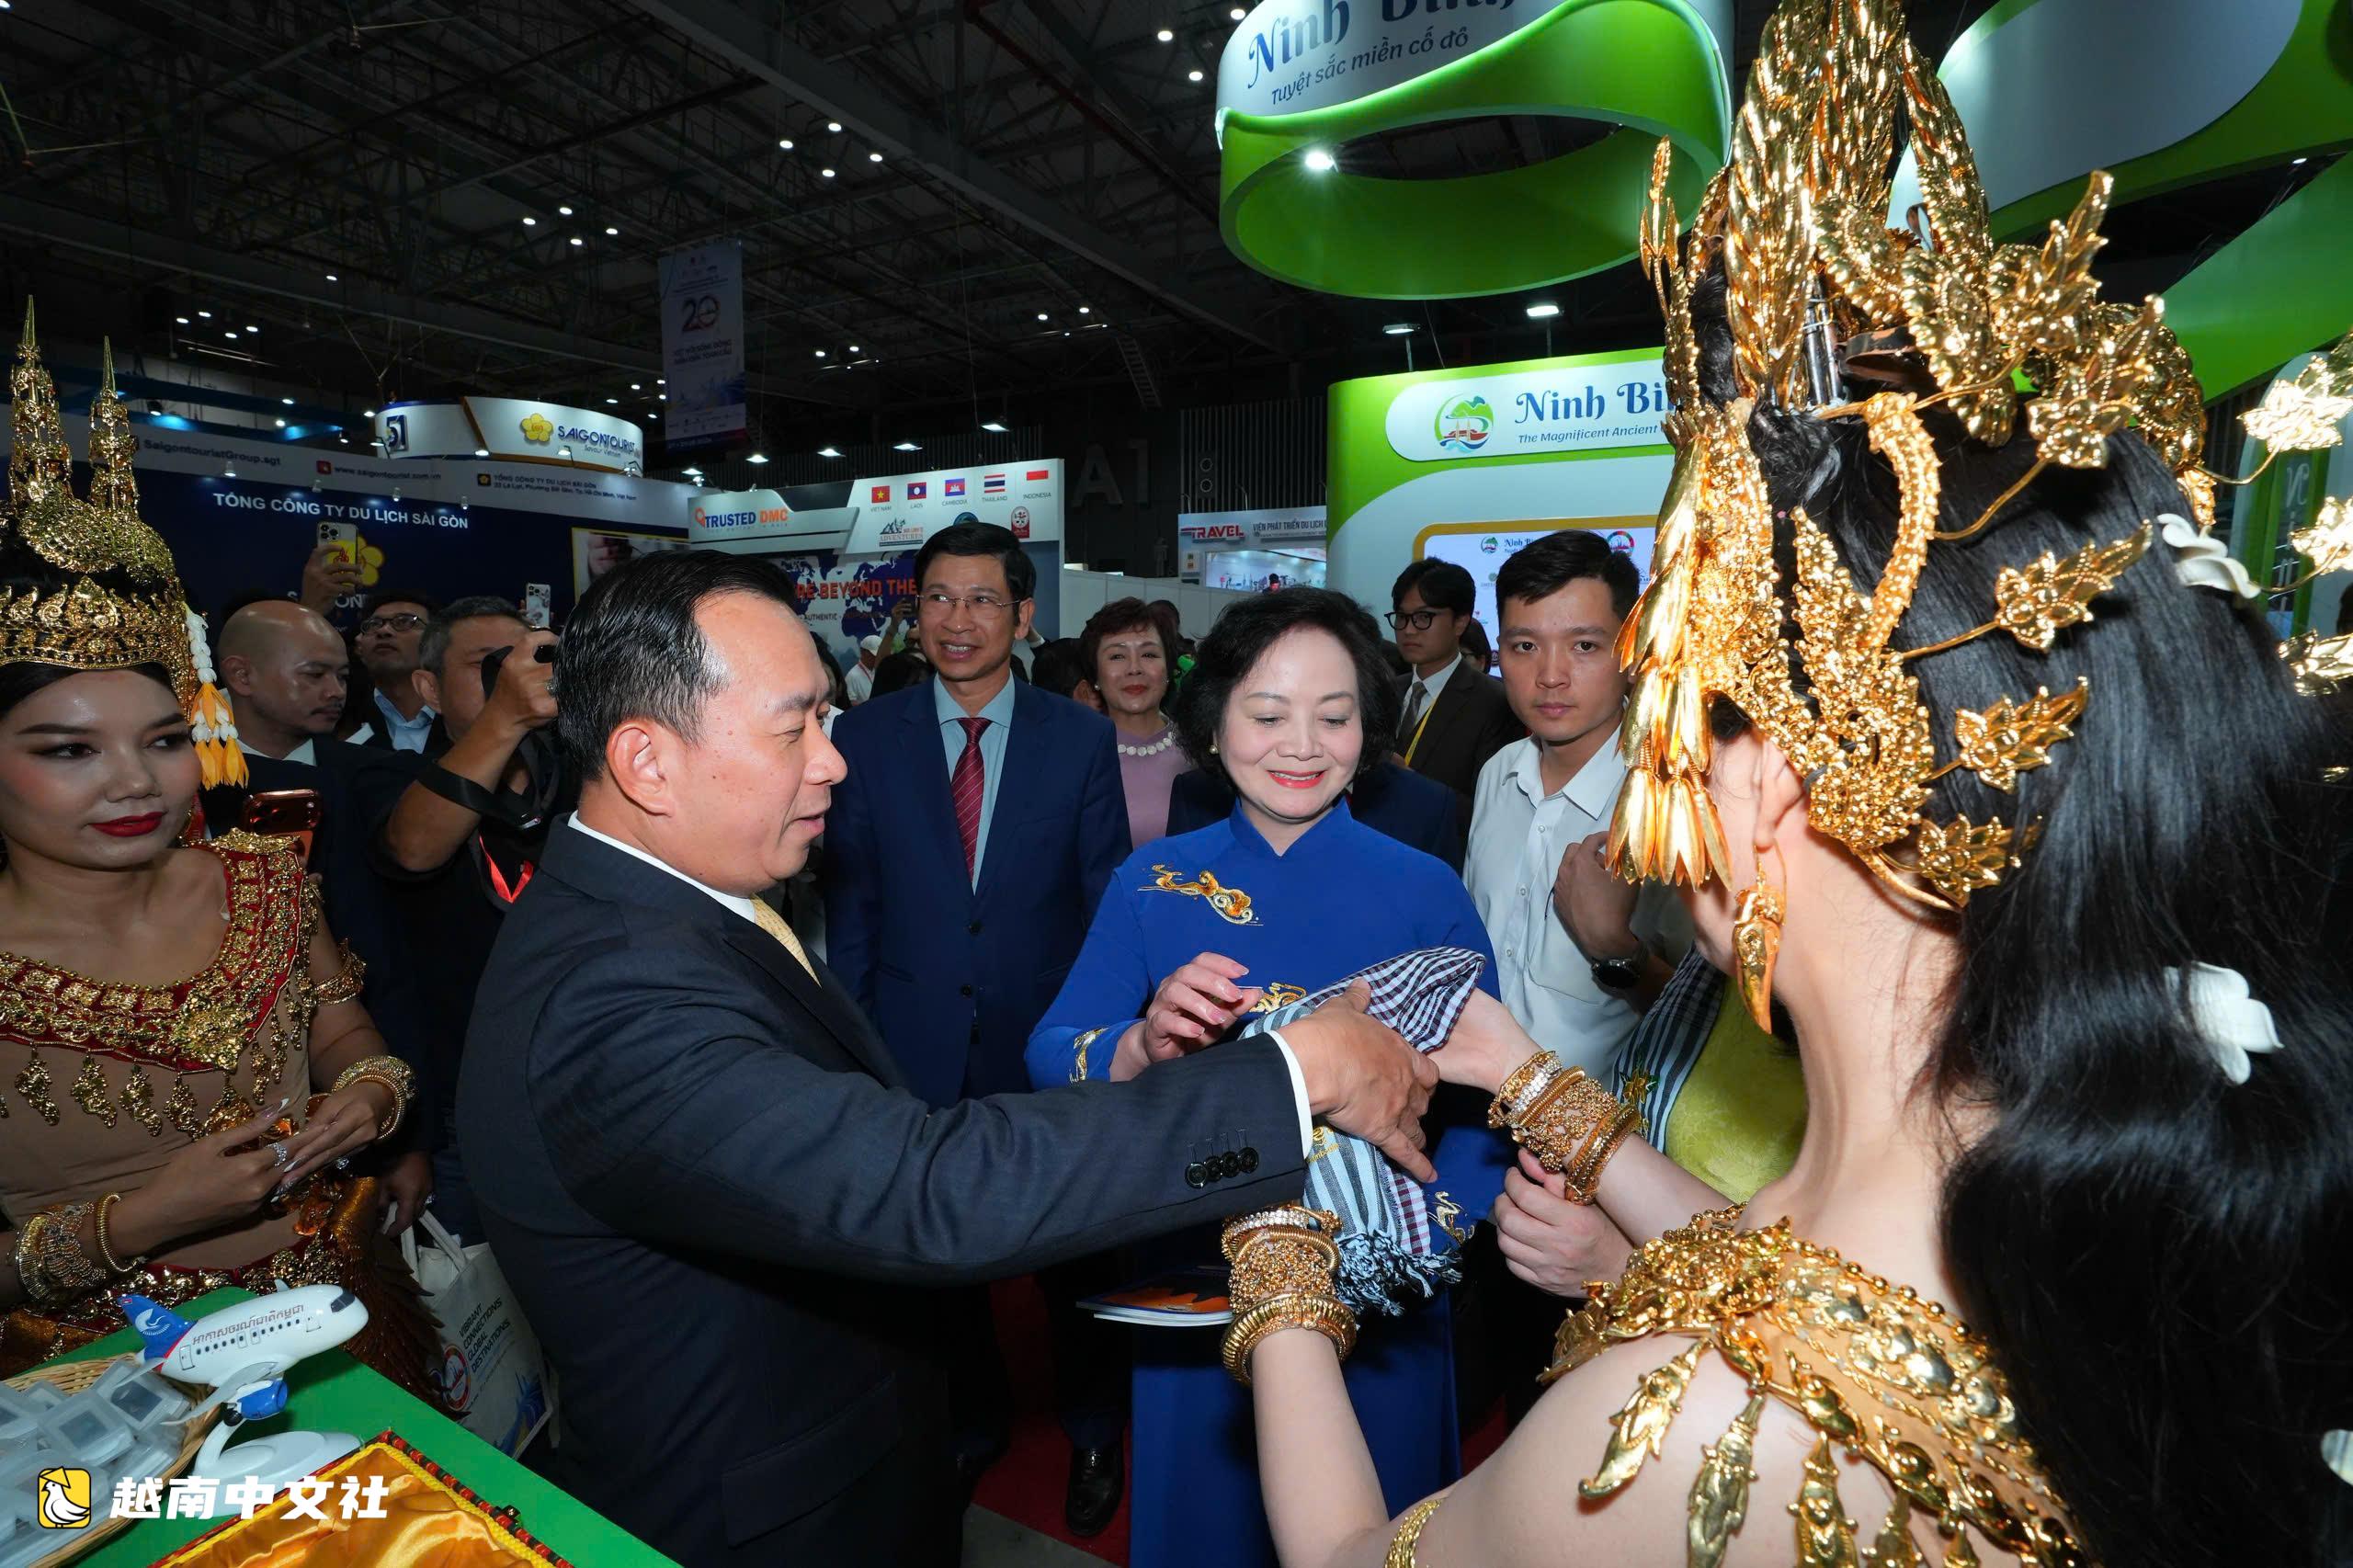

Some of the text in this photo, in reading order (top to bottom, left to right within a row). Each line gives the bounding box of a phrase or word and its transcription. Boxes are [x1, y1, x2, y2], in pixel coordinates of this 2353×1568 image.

[1247, 0, 1351, 90] Ninh
[1272, 71, 1312, 106] Tuyệt
[1314, 54, 1347, 84] sắc
[1351, 37, 1403, 71] miền
[1440, 27, 1469, 50] đô
[1515, 385, 1606, 424] Ninh
[558, 426, 636, 453] SAIGONTOURIST
[1518, 424, 1658, 444] The Magnificent Ancient
[941, 498, 968, 506] CAMBODIA
[982, 494, 1007, 503] THAILAND
[1022, 492, 1051, 500] INDONESIA
[270, 498, 321, 515] CÔNG
[324, 504, 346, 517] TY
[349, 506, 370, 519] DU
[374, 509, 408, 524] LỊCH
[412, 511, 436, 526] SÀI
[438, 515, 469, 529] GÒN
[705, 508, 789, 528] TRUSTED DMC
[1301, 520, 1309, 529] DU
[1180, 524, 1246, 540] TRAVEL
[820, 579, 882, 599] BEYOND
[886, 577, 918, 596] THE
[459, 1302, 483, 1338] VIBRANT
[463, 1296, 503, 1350] CONNECTIONS
[467, 1331, 489, 1361] GLOBAL
[471, 1318, 512, 1373] DESTINATIONS
